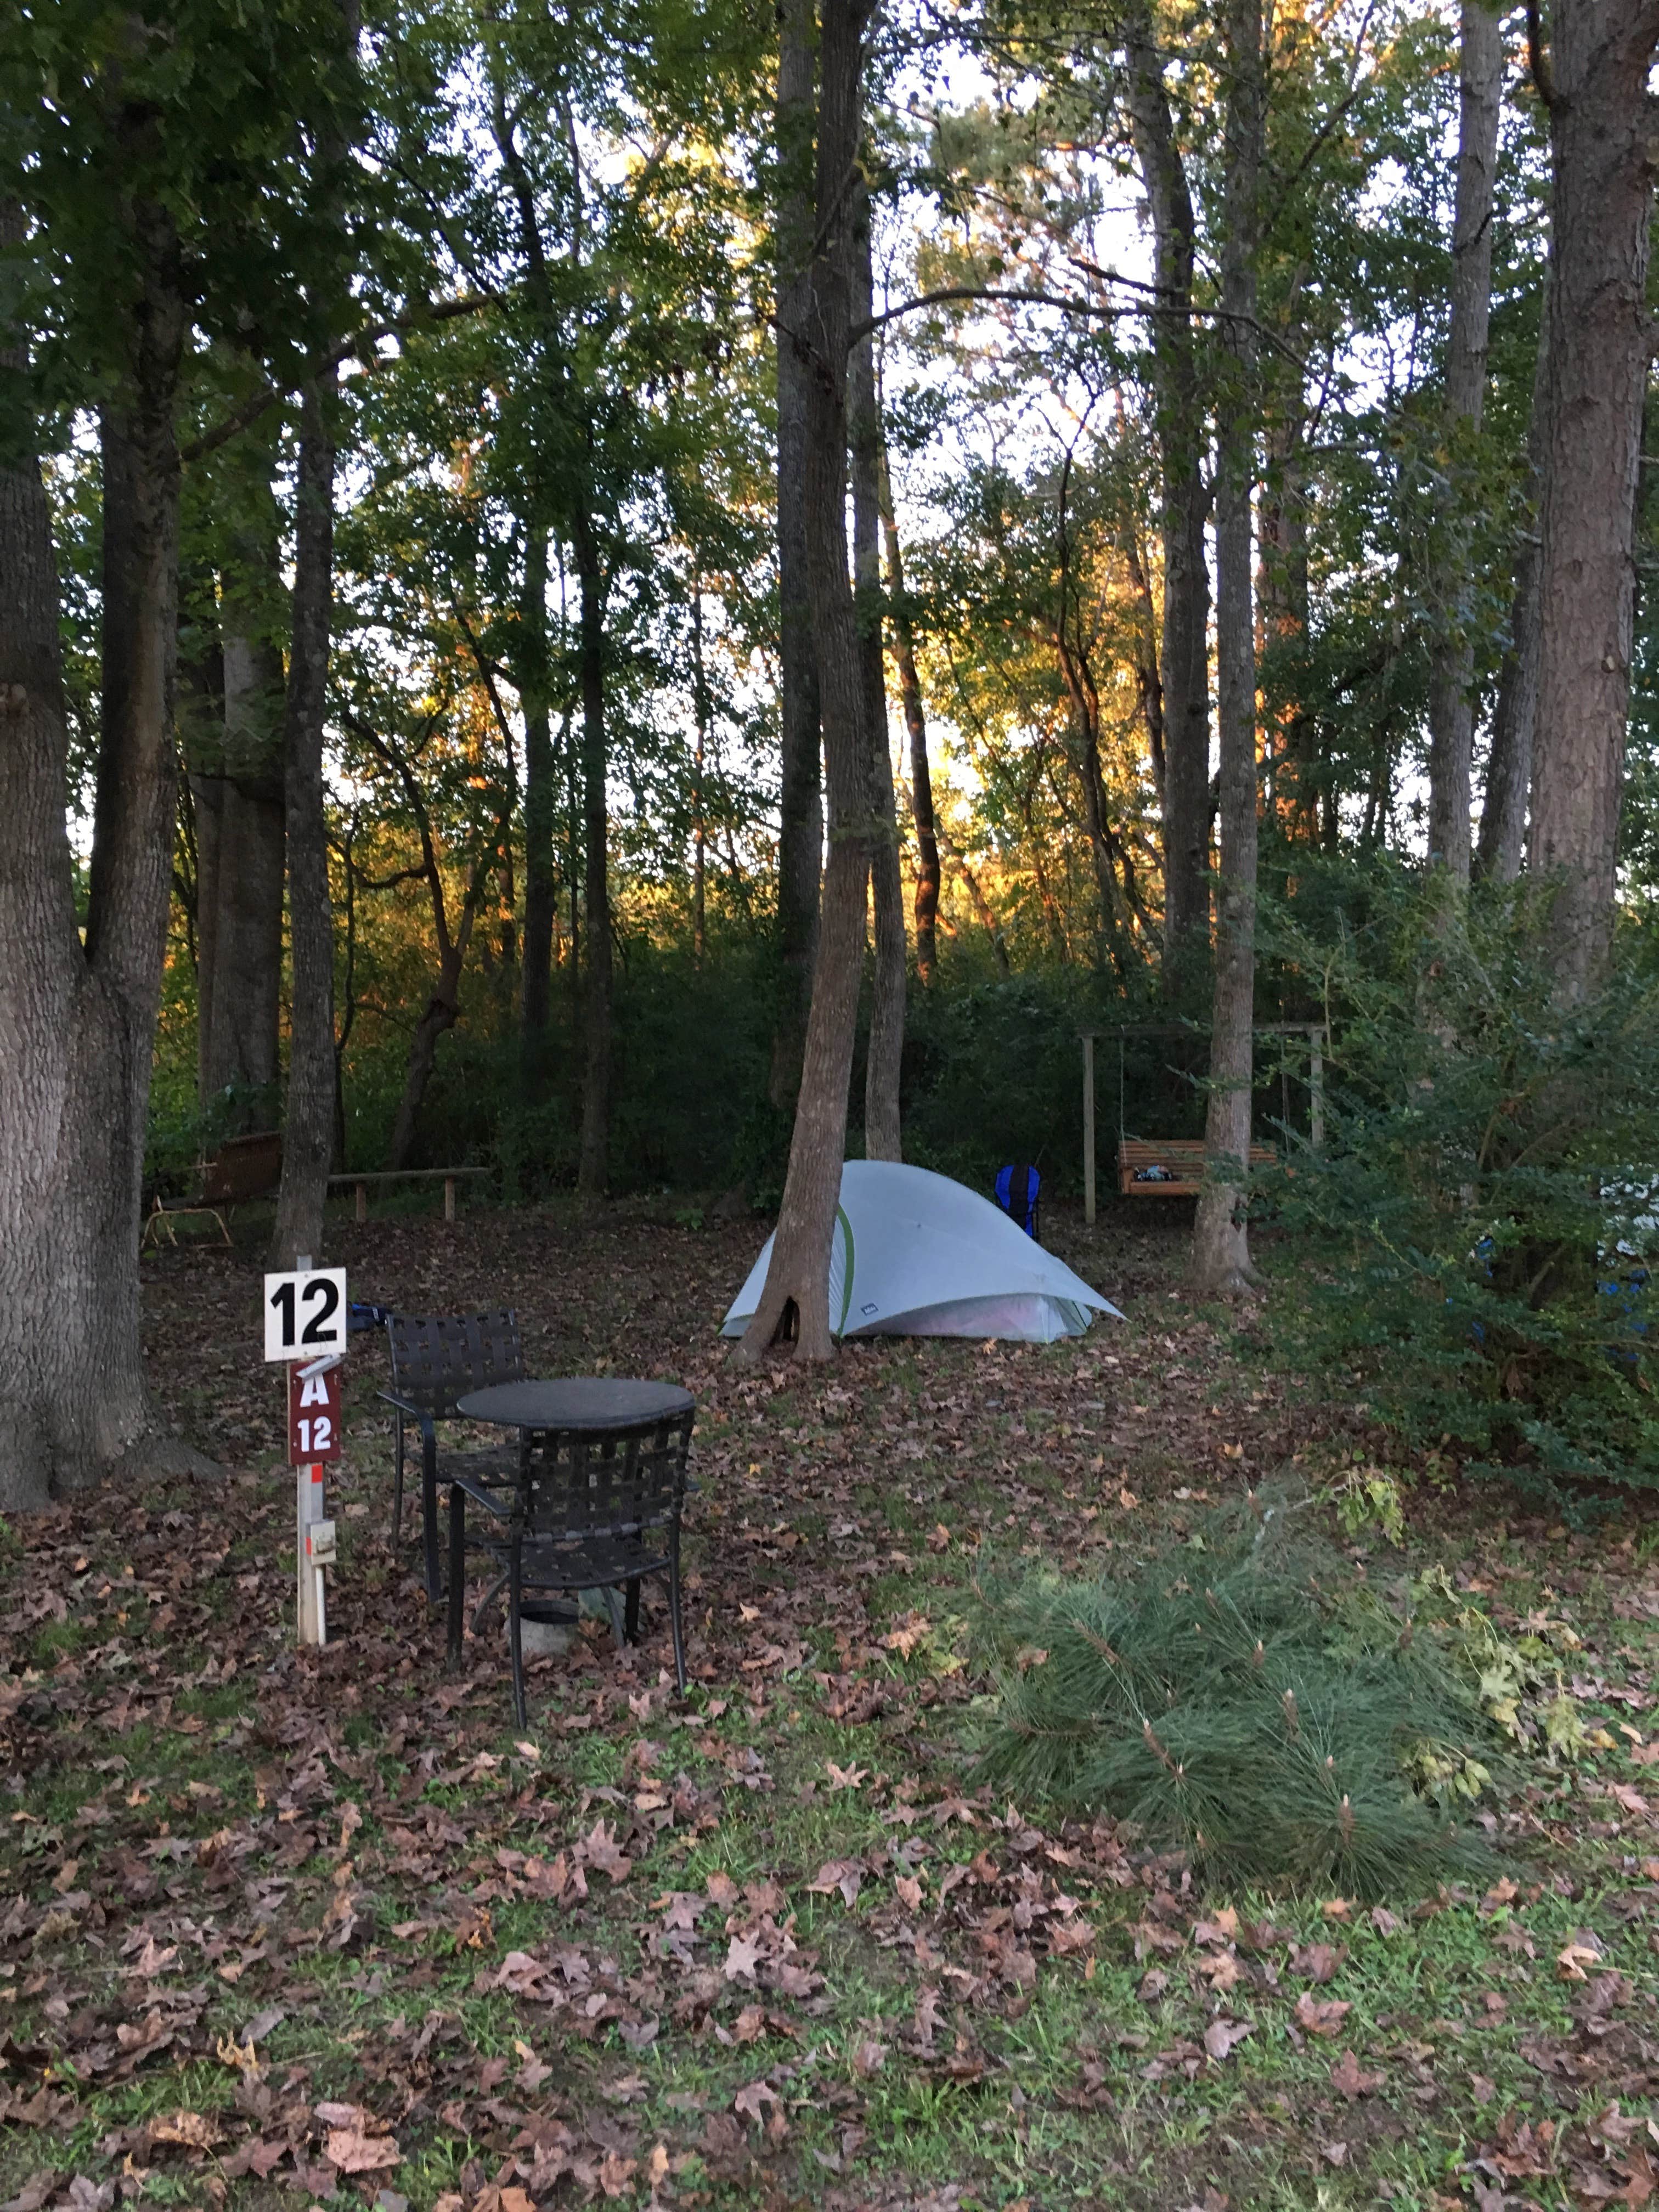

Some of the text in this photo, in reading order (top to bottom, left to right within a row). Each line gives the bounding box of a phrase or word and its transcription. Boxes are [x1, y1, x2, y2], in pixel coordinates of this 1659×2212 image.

[270, 1278, 339, 1347] 12
[300, 1372, 329, 1408] A
[297, 1416, 331, 1452] 12
